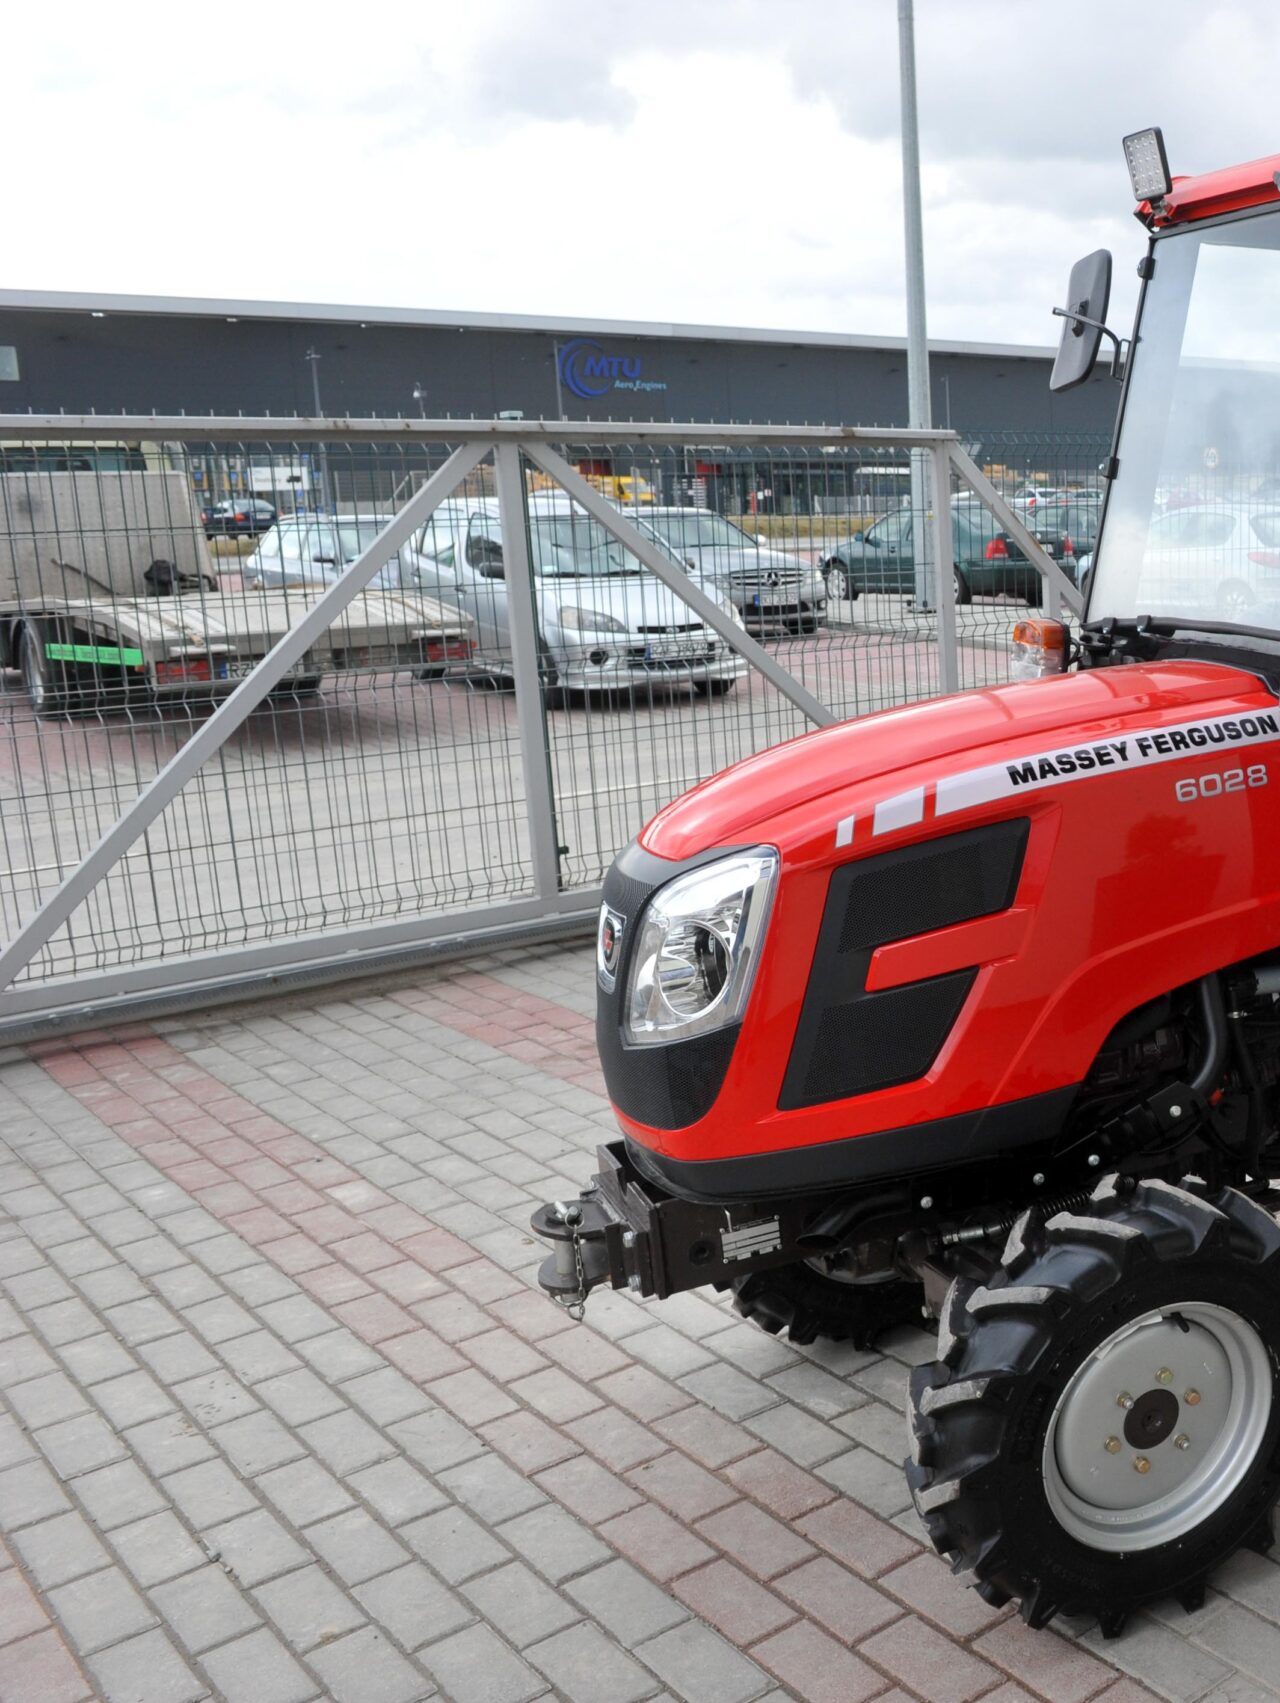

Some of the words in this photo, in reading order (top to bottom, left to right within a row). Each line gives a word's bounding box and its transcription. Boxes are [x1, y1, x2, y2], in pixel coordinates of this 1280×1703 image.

[584, 355, 642, 379] MTU
[614, 380, 635, 390] Aero
[635, 380, 667, 391] Engines
[1006, 740, 1130, 786] MASSEY
[1137, 714, 1280, 758] FERGUSON
[1175, 764, 1269, 803] 6028
